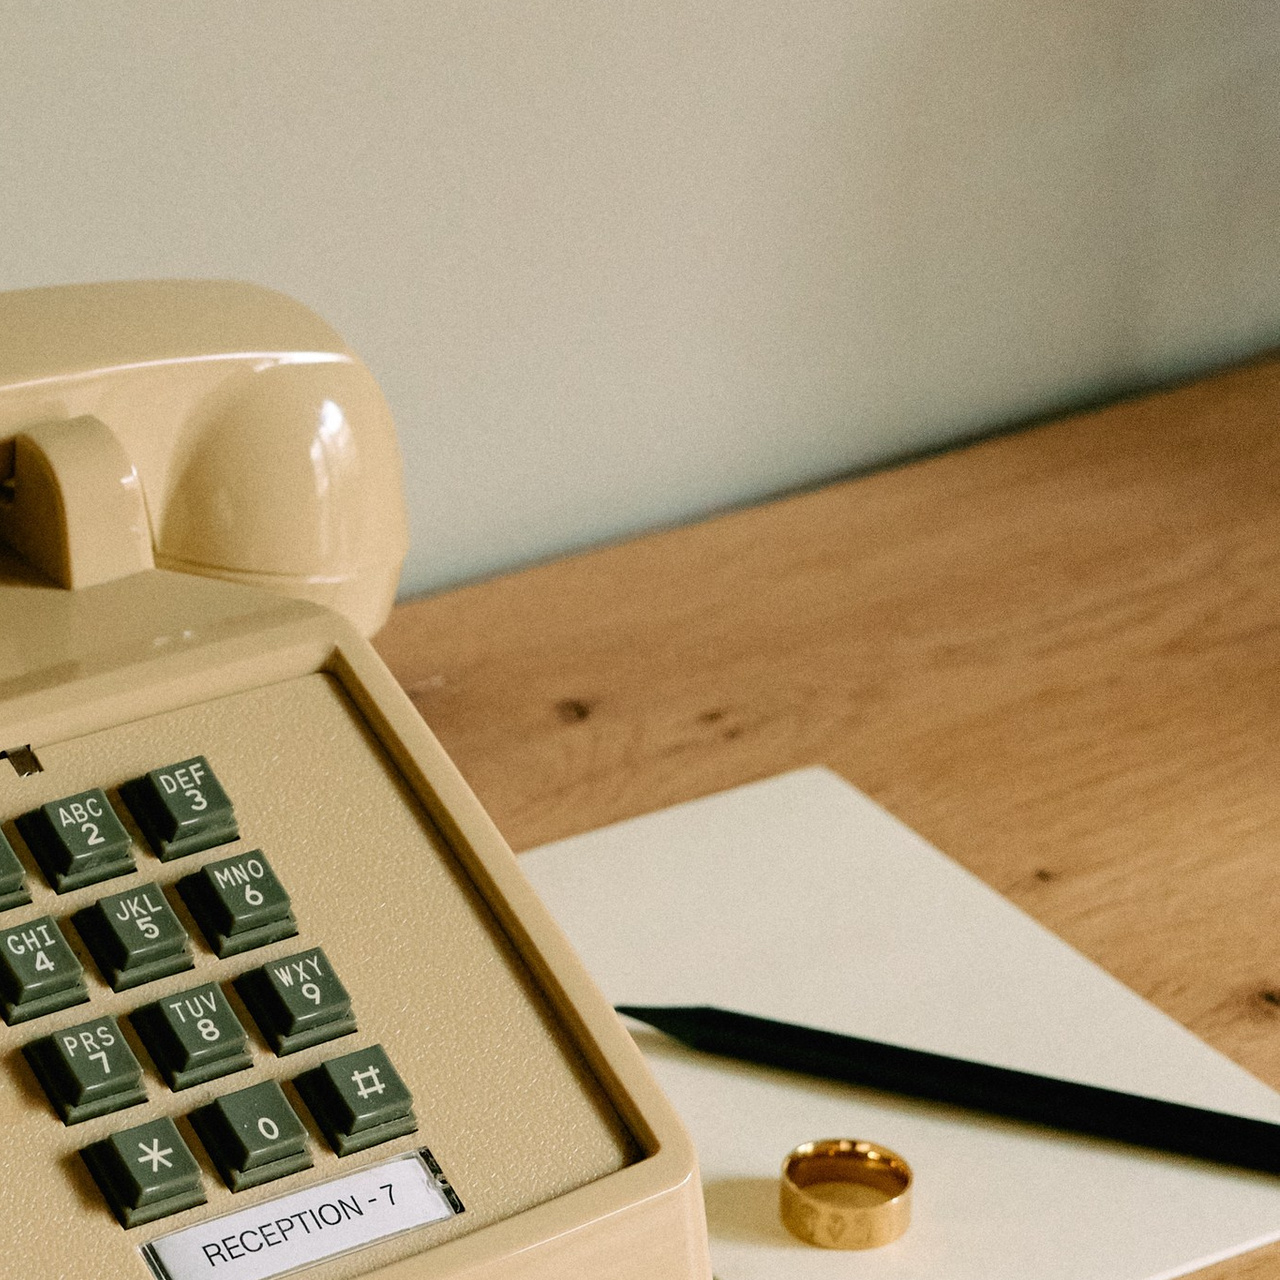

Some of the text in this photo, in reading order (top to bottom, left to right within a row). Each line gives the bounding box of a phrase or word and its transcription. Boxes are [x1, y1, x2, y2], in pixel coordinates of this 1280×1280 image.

[158, 762, 206, 794] DEF
[58, 798, 103, 828] ABC
[184, 789, 208, 811] 3
[81, 822, 106, 846] 2
[213, 858, 264, 890] MNO
[116, 893, 163, 921] JKL
[244, 884, 264, 906] 6
[6, 924, 56, 955] GHI
[135, 915, 160, 939] 5
[35, 950, 55, 972] 4
[273, 955, 324, 988] WXY
[169, 991, 218, 1023] TUV
[301, 982, 321, 1005] 9
[62, 1025, 115, 1058] PRS
[196, 1018, 221, 1042] 8
[88, 1050, 111, 1074] 7
[350, 1065, 386, 1100] #
[257, 1117, 280, 1140] 0
[201, 1194, 365, 1267] RECEPTION
[379, 1183, 396, 1206] 7
